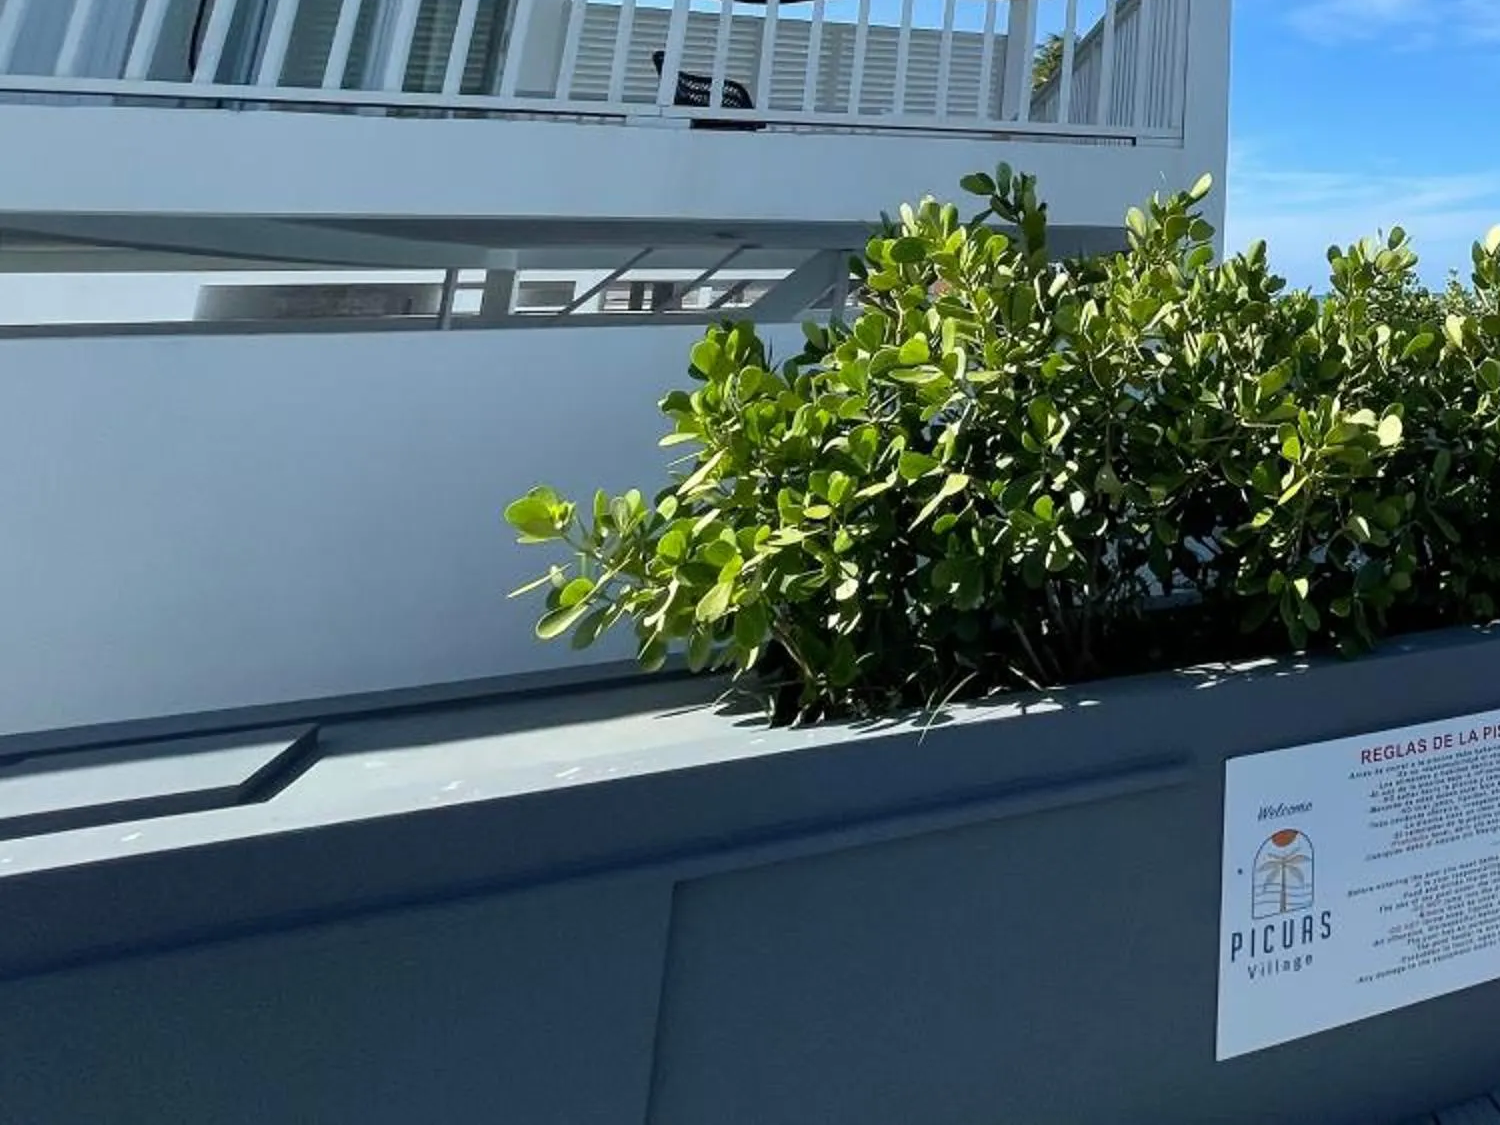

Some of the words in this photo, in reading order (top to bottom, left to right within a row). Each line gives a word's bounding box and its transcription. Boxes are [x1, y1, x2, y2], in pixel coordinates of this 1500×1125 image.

[1361, 738, 1427, 764] REGLAS
[1433, 734, 1453, 750] DE
[1459, 729, 1479, 746] LA
[1257, 801, 1313, 822] Welcome
[1231, 911, 1332, 963] PICUAS
[1247, 954, 1313, 979] Village
